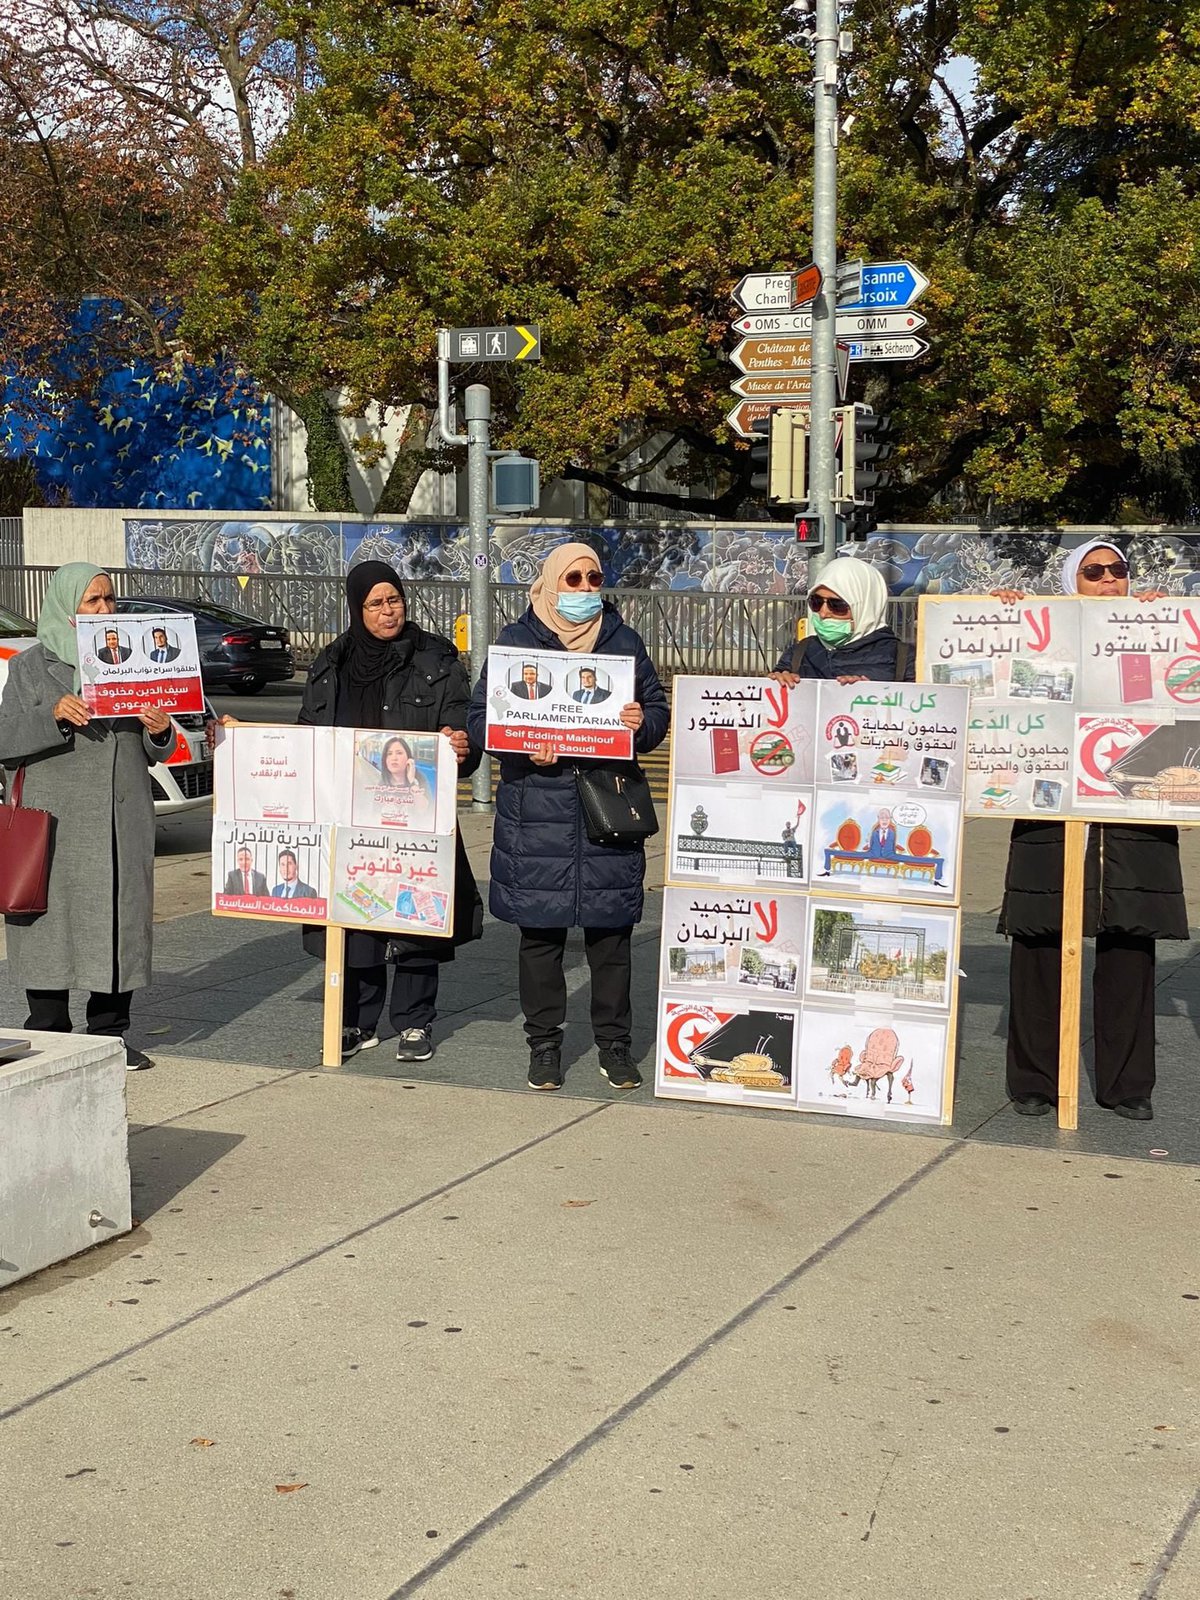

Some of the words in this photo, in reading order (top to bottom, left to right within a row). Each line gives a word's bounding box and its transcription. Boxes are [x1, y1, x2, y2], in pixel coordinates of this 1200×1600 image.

[765, 278, 790, 291] Preg
[864, 271, 905, 285] sanne
[756, 293, 790, 305] Cham
[859, 287, 898, 303] ersoix
[755, 318, 780, 330] OMS
[793, 316, 811, 328] CIC
[857, 317, 888, 330] OMM
[757, 342, 796, 354] Château
[799, 341, 811, 352] de
[747, 356, 783, 368] Penthes
[791, 355, 811, 367] Mus
[746, 381, 773, 391] Musée
[774, 380, 785, 390] de
[787, 380, 811, 390] l'Aria
[953, 607, 1022, 631] لتجميد
[1107, 607, 1180, 630] لتجميد
[1024, 606, 1051, 652] لا
[939, 637, 1020, 659] البرلمان
[102, 667, 133, 676] البرلمان
[153, 667, 173, 675] سراح
[174, 664, 198, 674] أطلقوا
[98, 687, 134, 698] مخلوف
[136, 686, 163, 697] الدين
[164, 685, 189, 696] سيف
[701, 685, 763, 707] لتجميد
[112, 700, 151, 713] سعودي
[152, 697, 178, 709] نضال
[552, 703, 583, 714] FREE
[764, 684, 790, 729] لا
[909, 693, 937, 714] كل
[862, 718, 904, 734] لحماية
[908, 717, 958, 737] محامون
[968, 709, 1010, 731] الدّع
[1017, 712, 1046, 735] كل
[527, 730, 563, 741] Eddine
[566, 733, 614, 744] Makhlouf
[860, 736, 909, 751] والحريات
[523, 740, 556, 751] Nidl
[558, 743, 596, 753] Saoudi
[913, 737, 957, 752] الحقوق
[968, 743, 1012, 758] لحماية
[1017, 743, 1069, 758] محامون
[260, 755, 288, 766] أساتذة
[967, 760, 1019, 774] والحريات
[1023, 760, 1069, 774] الحقوق
[250, 768, 282, 779] الإنقلاب
[284, 769, 297, 778] ضد
[226, 826, 274, 845] للأحرار
[277, 829, 322, 849] الحرية
[348, 833, 389, 850] السفر
[394, 839, 438, 857] تحجير
[346, 856, 403, 881] قانوني
[407, 861, 439, 882] غير
[218, 896, 261, 911] السياسية
[262, 901, 316, 915] للمحاكمات
[317, 906, 325, 915] لا
[689, 898, 751, 920] لتجميد
[753, 899, 779, 944] لا
[676, 923, 750, 947] البرلمان
